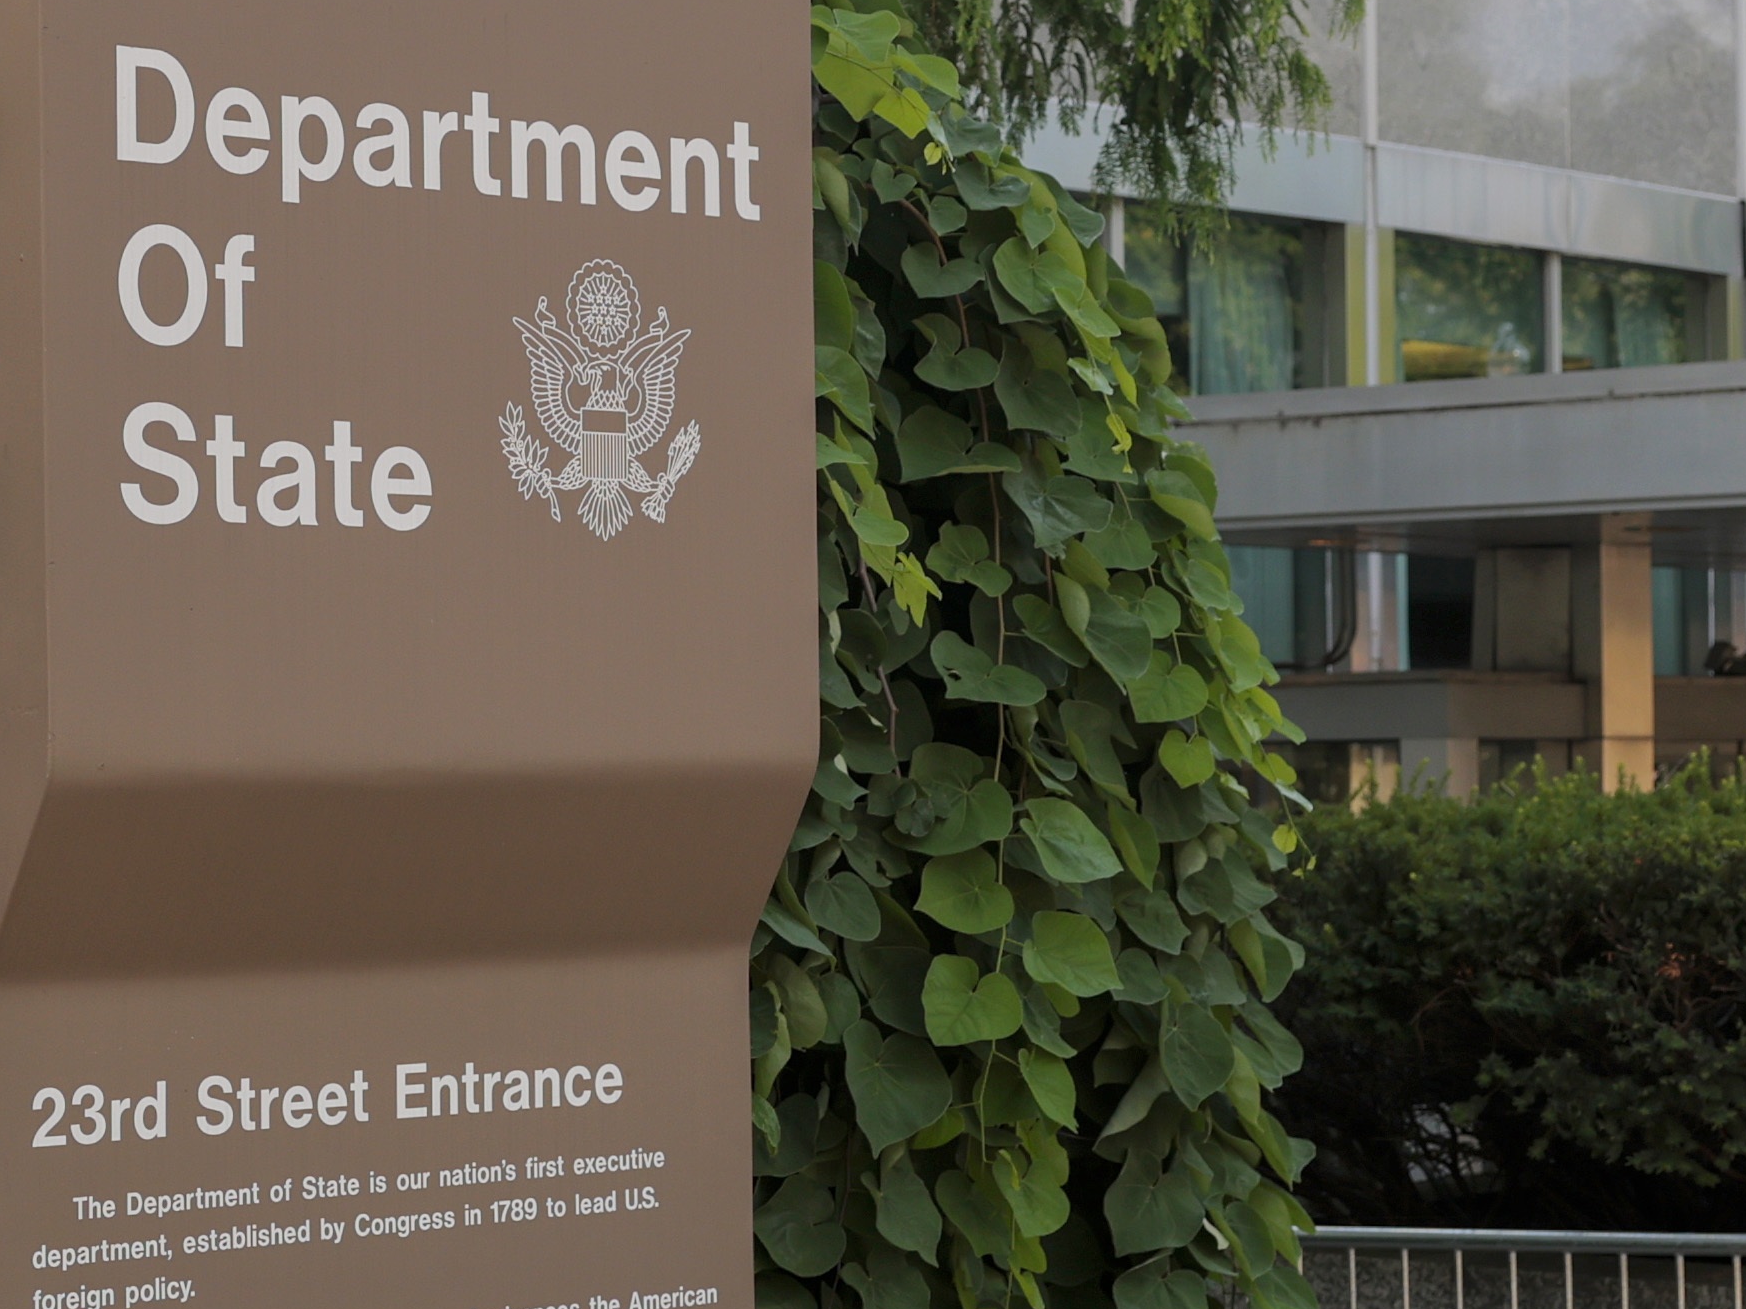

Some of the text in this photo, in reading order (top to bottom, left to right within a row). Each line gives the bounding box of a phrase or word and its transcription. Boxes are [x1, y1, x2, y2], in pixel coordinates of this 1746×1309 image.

[116, 44, 761, 221] Department
[118, 224, 255, 348] Of
[120, 401, 433, 531] State
[31, 1061, 624, 1148] 23rd Street Entrance
[72, 1147, 665, 1221] The Department of State is our nation's first executive
[32, 1186, 660, 1272] department, established by Congress in 1789 to lead U.S.
[125, 1276, 196, 1309] policy.
